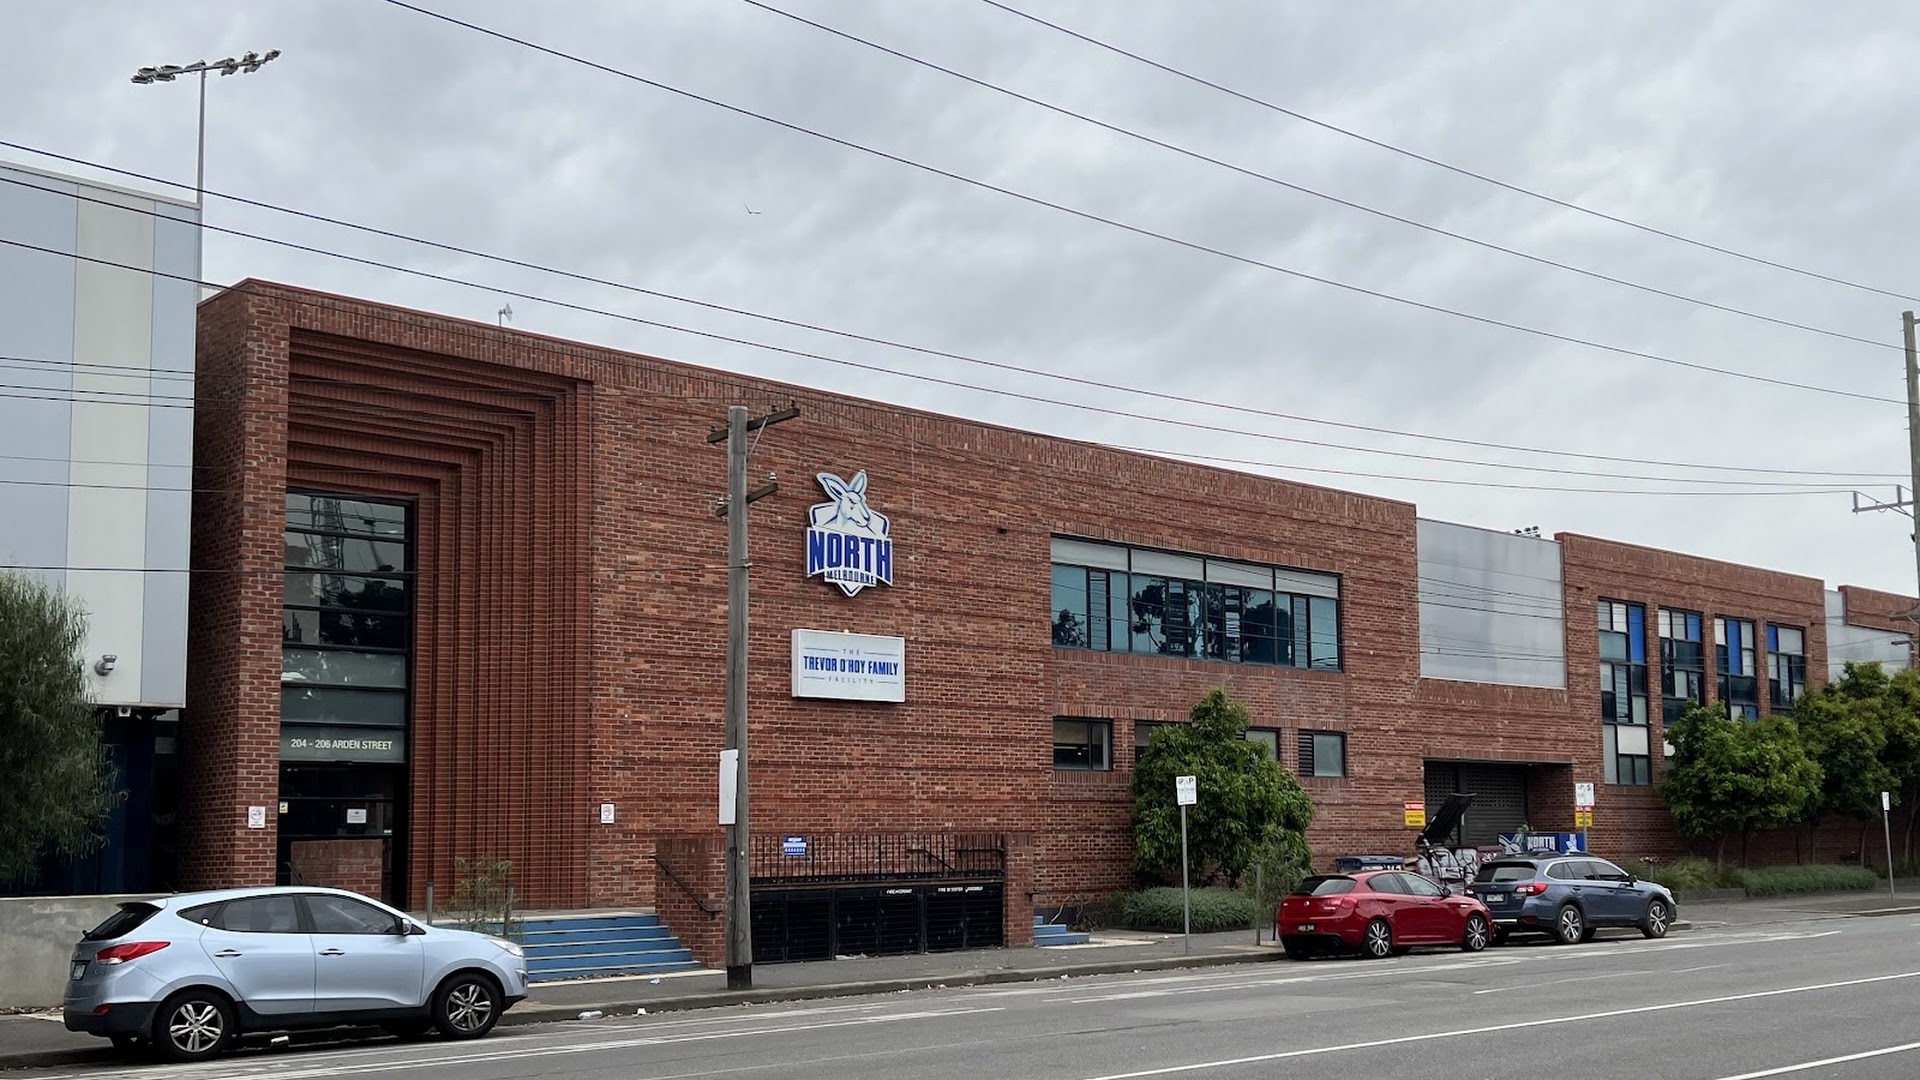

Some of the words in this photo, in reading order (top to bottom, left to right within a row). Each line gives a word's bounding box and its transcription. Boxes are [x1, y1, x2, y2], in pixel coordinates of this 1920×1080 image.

[809, 529, 891, 583] NORTH
[826, 569, 875, 585] MELBOURNE
[843, 648, 861, 656] THE
[803, 655, 838, 672] TREVOR
[840, 658, 866, 674] O'HOY
[868, 660, 899, 676] FAMILY
[828, 676, 874, 685] FACILITY
[290, 738, 307, 748] 204
[314, 739, 332, 749] 206
[332, 739, 360, 750] ARDEN
[361, 740, 393, 750] STREET
[1527, 836, 1556, 851] NORTH
